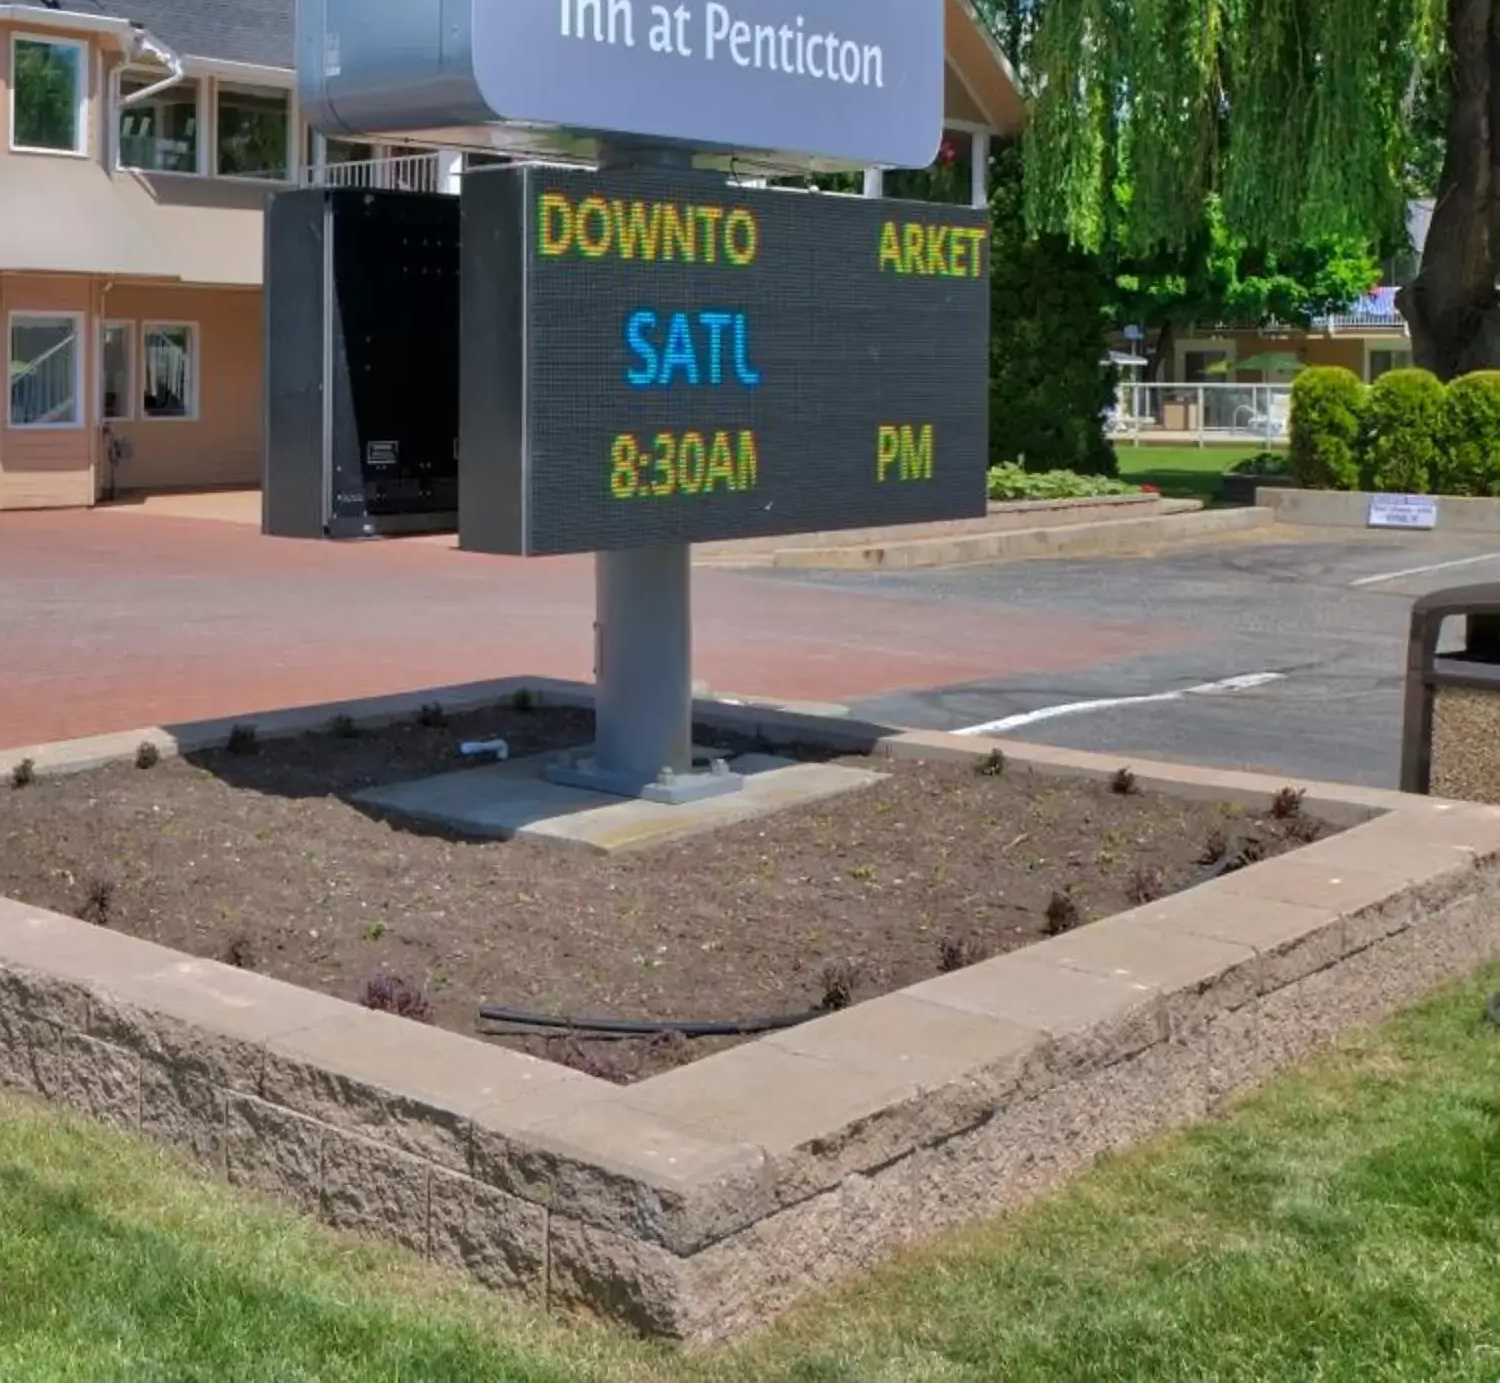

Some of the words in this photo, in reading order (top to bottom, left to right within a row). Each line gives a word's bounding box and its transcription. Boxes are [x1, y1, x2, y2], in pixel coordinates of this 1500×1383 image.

[649, 3, 691, 58] at
[705, 1, 884, 88] Penticton
[537, 190, 758, 266] DOWNTO
[877, 425, 933, 482] PM
